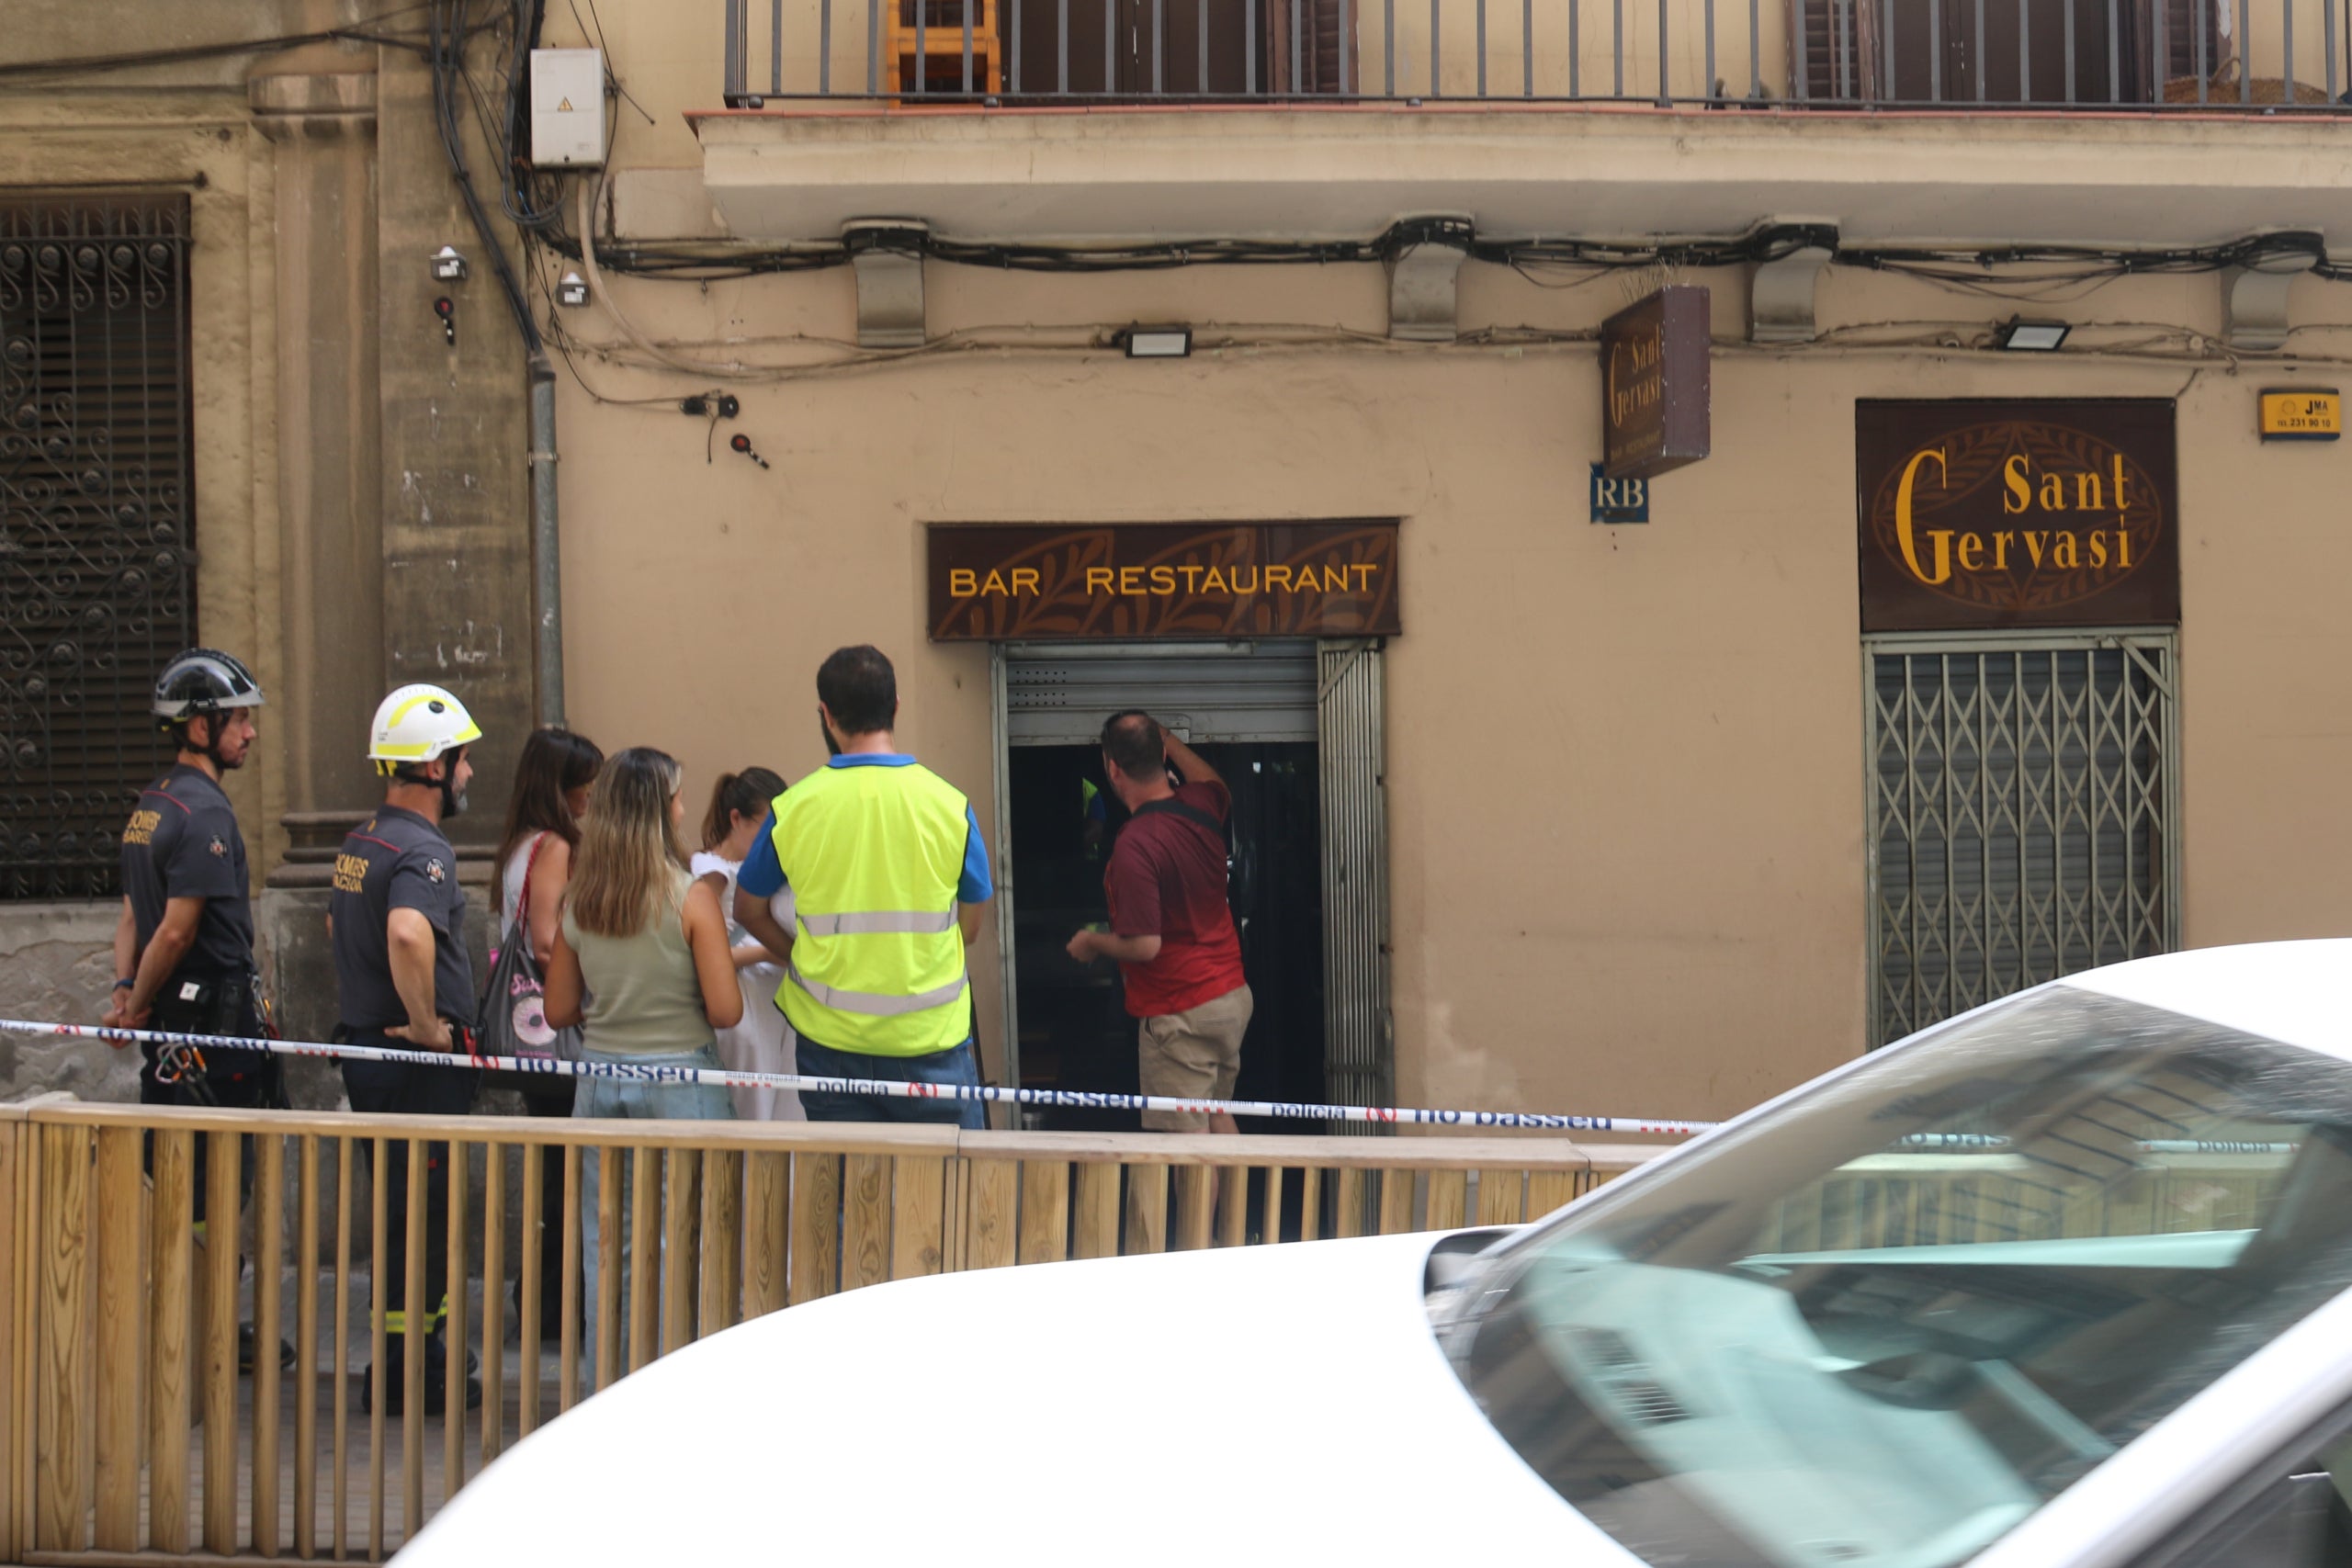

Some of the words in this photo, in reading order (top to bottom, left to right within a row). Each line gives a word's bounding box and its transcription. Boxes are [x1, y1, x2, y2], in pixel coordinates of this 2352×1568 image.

[1633, 323, 1660, 373] Sant
[1610, 343, 1660, 428] Gervasi
[2305, 400, 2328, 415] JMA
[1595, 477, 1645, 508] RB
[2004, 454, 2131, 514] Sant
[1895, 446, 2132, 585] Gervasi
[950, 569, 1040, 597] BAR
[1086, 563, 1377, 596] RESTAURANT
[515, 1056, 559, 1074] no
[571, 1059, 698, 1082] passeu
[817, 1077, 889, 1096] policia
[956, 1085, 1000, 1101] no
[1272, 1103, 1347, 1119] policia
[1415, 1108, 1461, 1124] no
[1476, 1111, 1611, 1131] passeu
